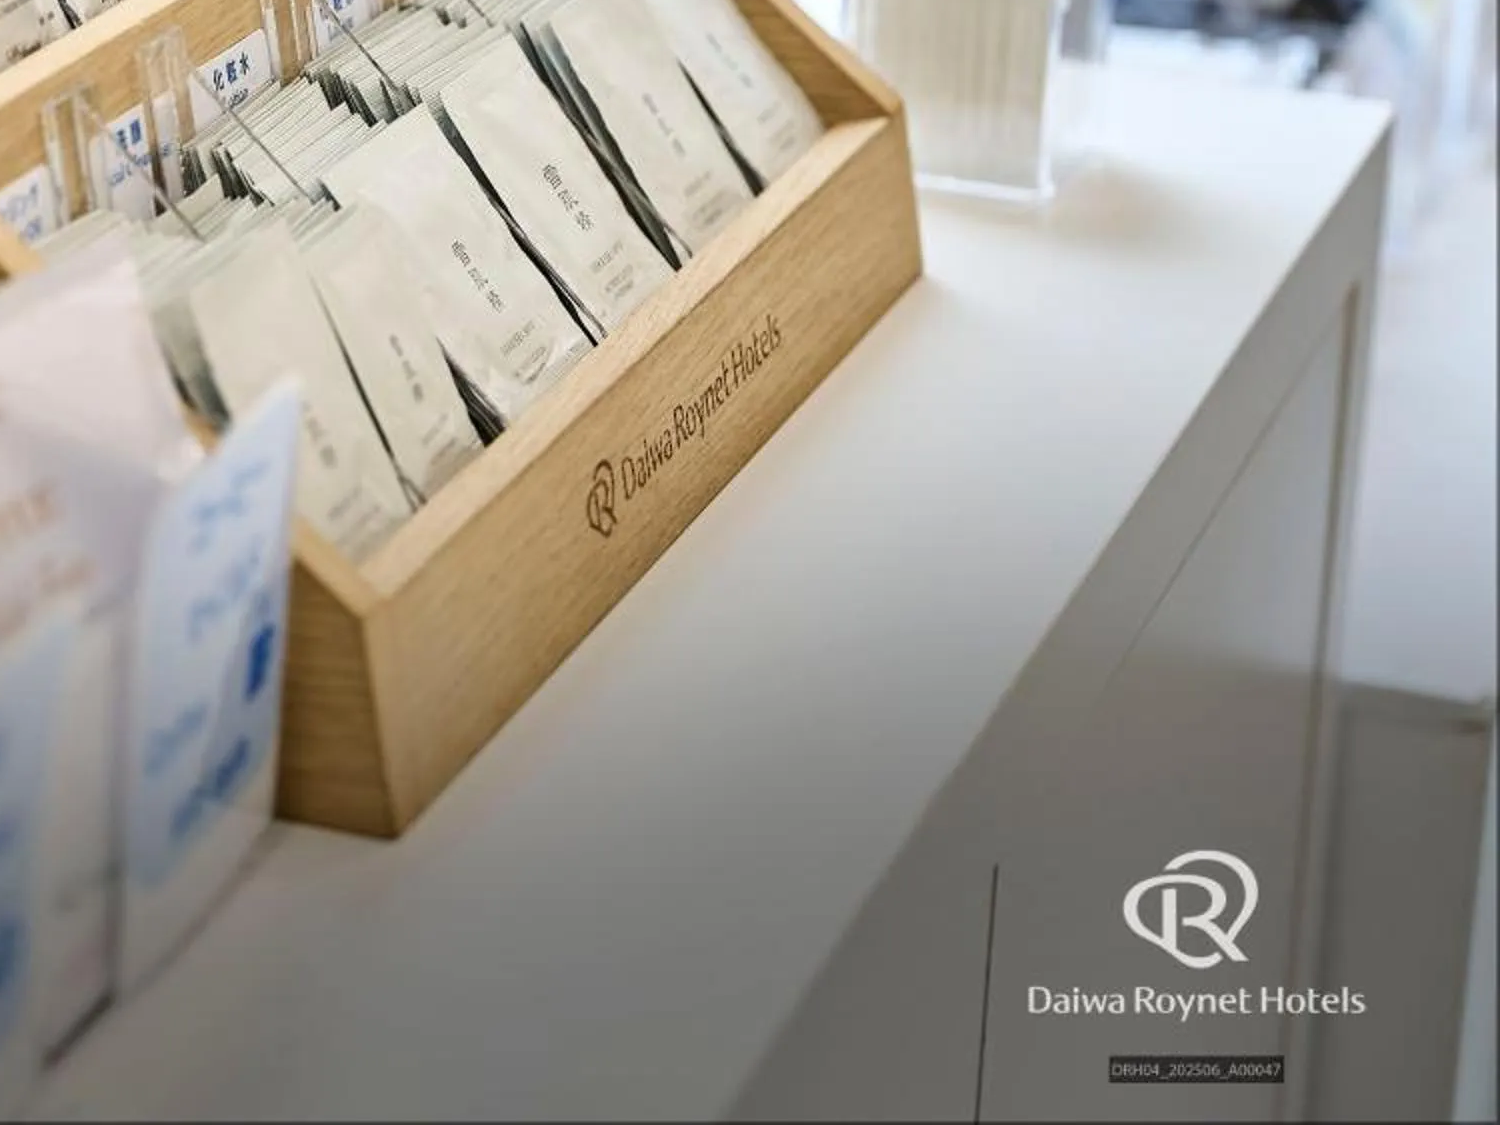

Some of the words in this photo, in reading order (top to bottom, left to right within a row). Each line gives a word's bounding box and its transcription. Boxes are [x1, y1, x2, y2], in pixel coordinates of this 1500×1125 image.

[620, 428, 674, 500] Daiwa
[672, 360, 731, 449] Roynet
[731, 314, 783, 389] Hotels
